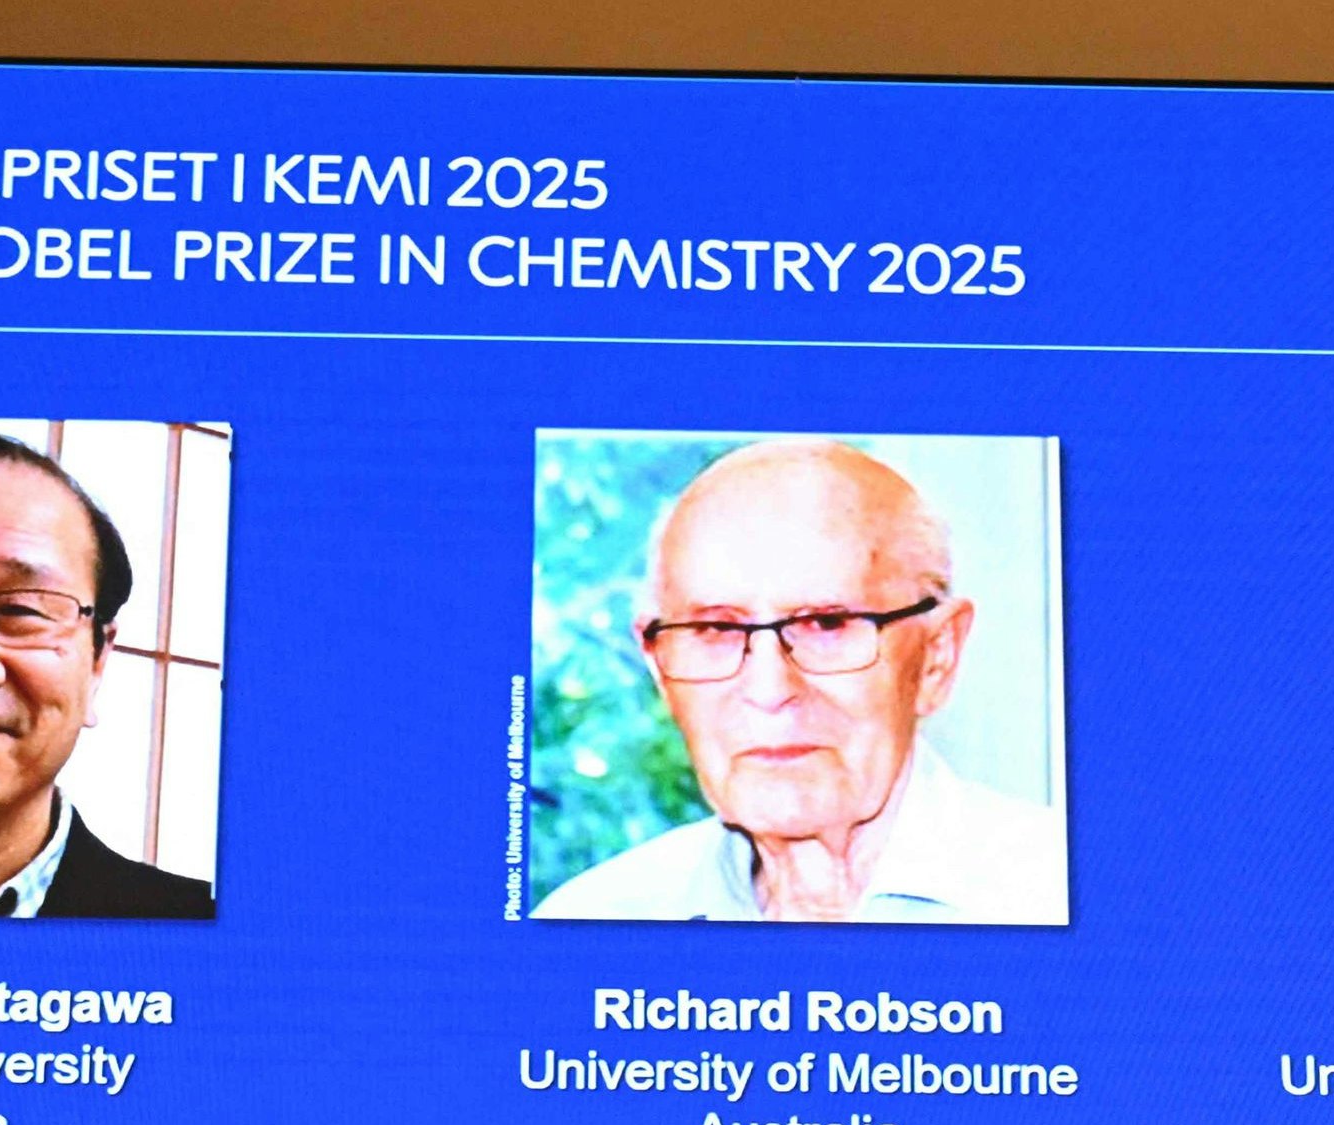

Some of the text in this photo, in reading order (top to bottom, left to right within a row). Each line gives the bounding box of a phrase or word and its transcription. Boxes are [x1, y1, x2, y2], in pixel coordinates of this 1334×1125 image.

[233, 153, 245, 203] I
[264, 153, 430, 206] KEMI
[446, 156, 608, 210] 2025
[174, 230, 356, 284] PRIZE
[380, 234, 446, 285] IN
[468, 235, 857, 292] CHEMISTRY
[868, 242, 1026, 296] 2025
[504, 674, 527, 922] Photo: University of Melbourne
[594, 988, 1003, 1034] Richard Robson
[520, 1049, 1079, 1102] University of Melbourne
